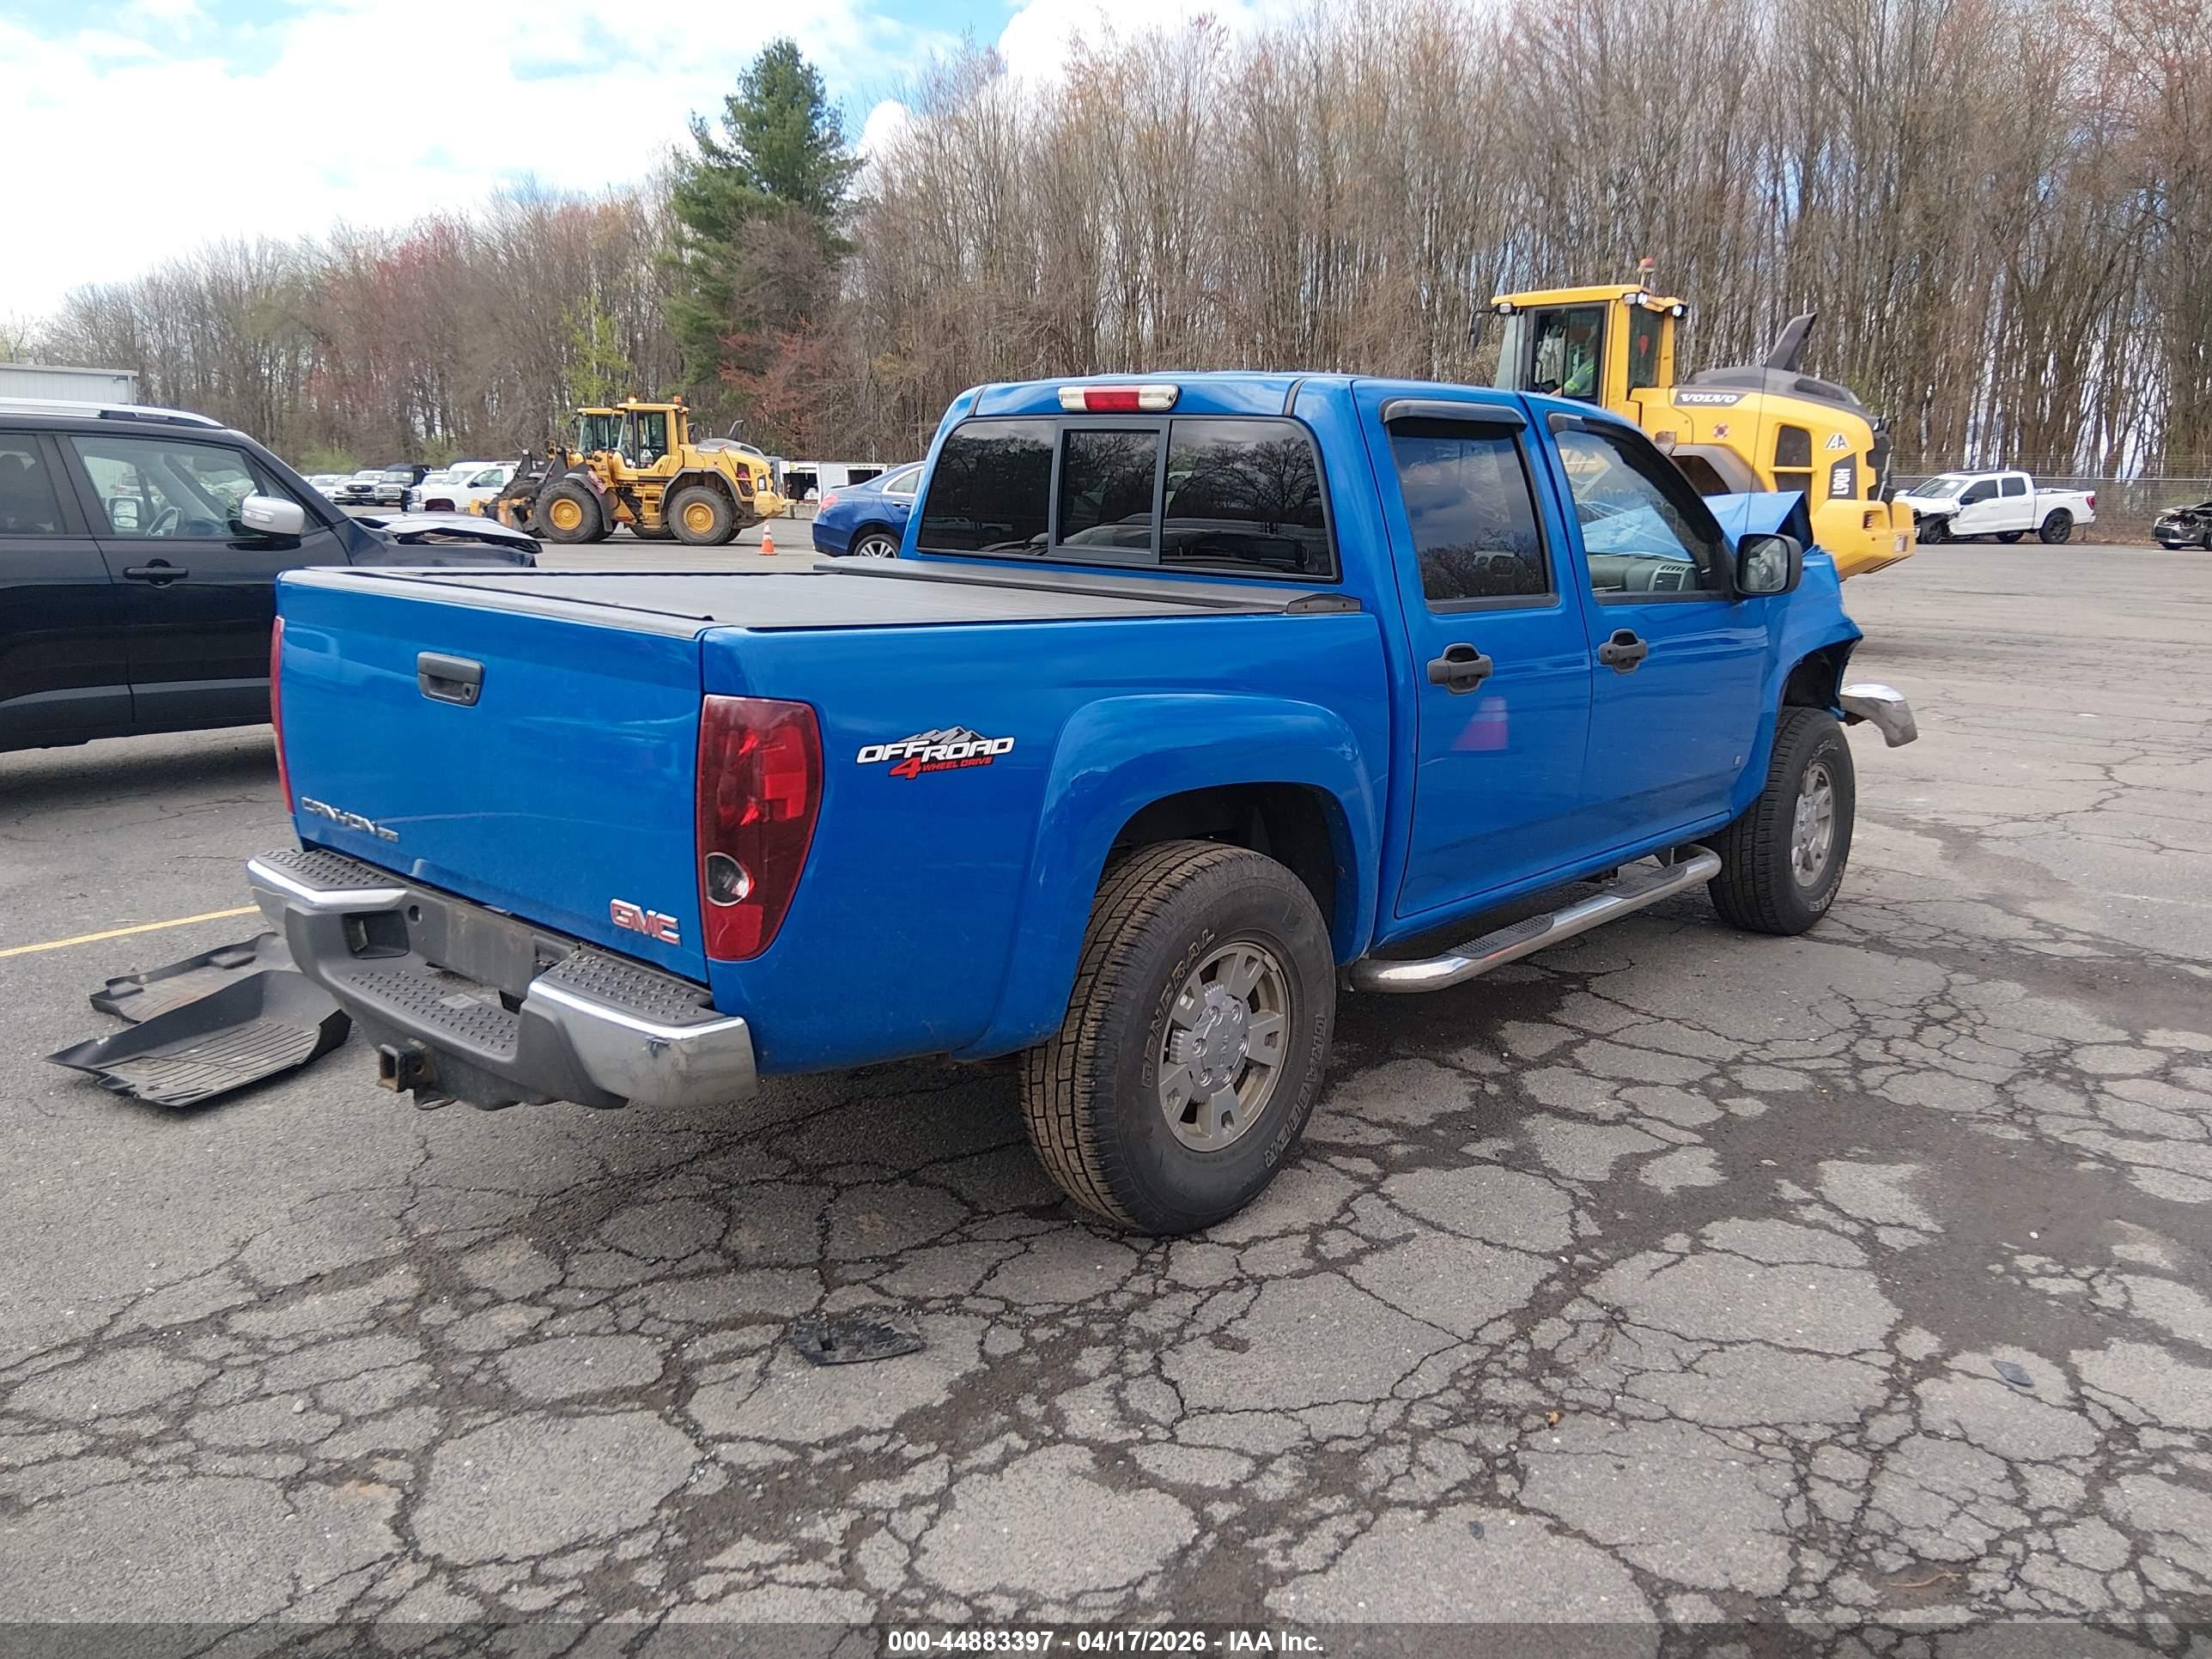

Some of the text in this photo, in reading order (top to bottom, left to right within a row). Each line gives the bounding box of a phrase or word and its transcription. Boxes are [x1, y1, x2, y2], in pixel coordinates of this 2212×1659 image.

[1680, 393, 1738, 404] VOLVO
[1832, 468, 1851, 495] L90H
[856, 737, 1015, 763] OFFROAD
[889, 756, 993, 780] 4 WHEEL DRIVE
[301, 796, 376, 836] CANYON
[610, 898, 682, 946] GMC
[1141, 928, 1215, 1088] GENERAL
